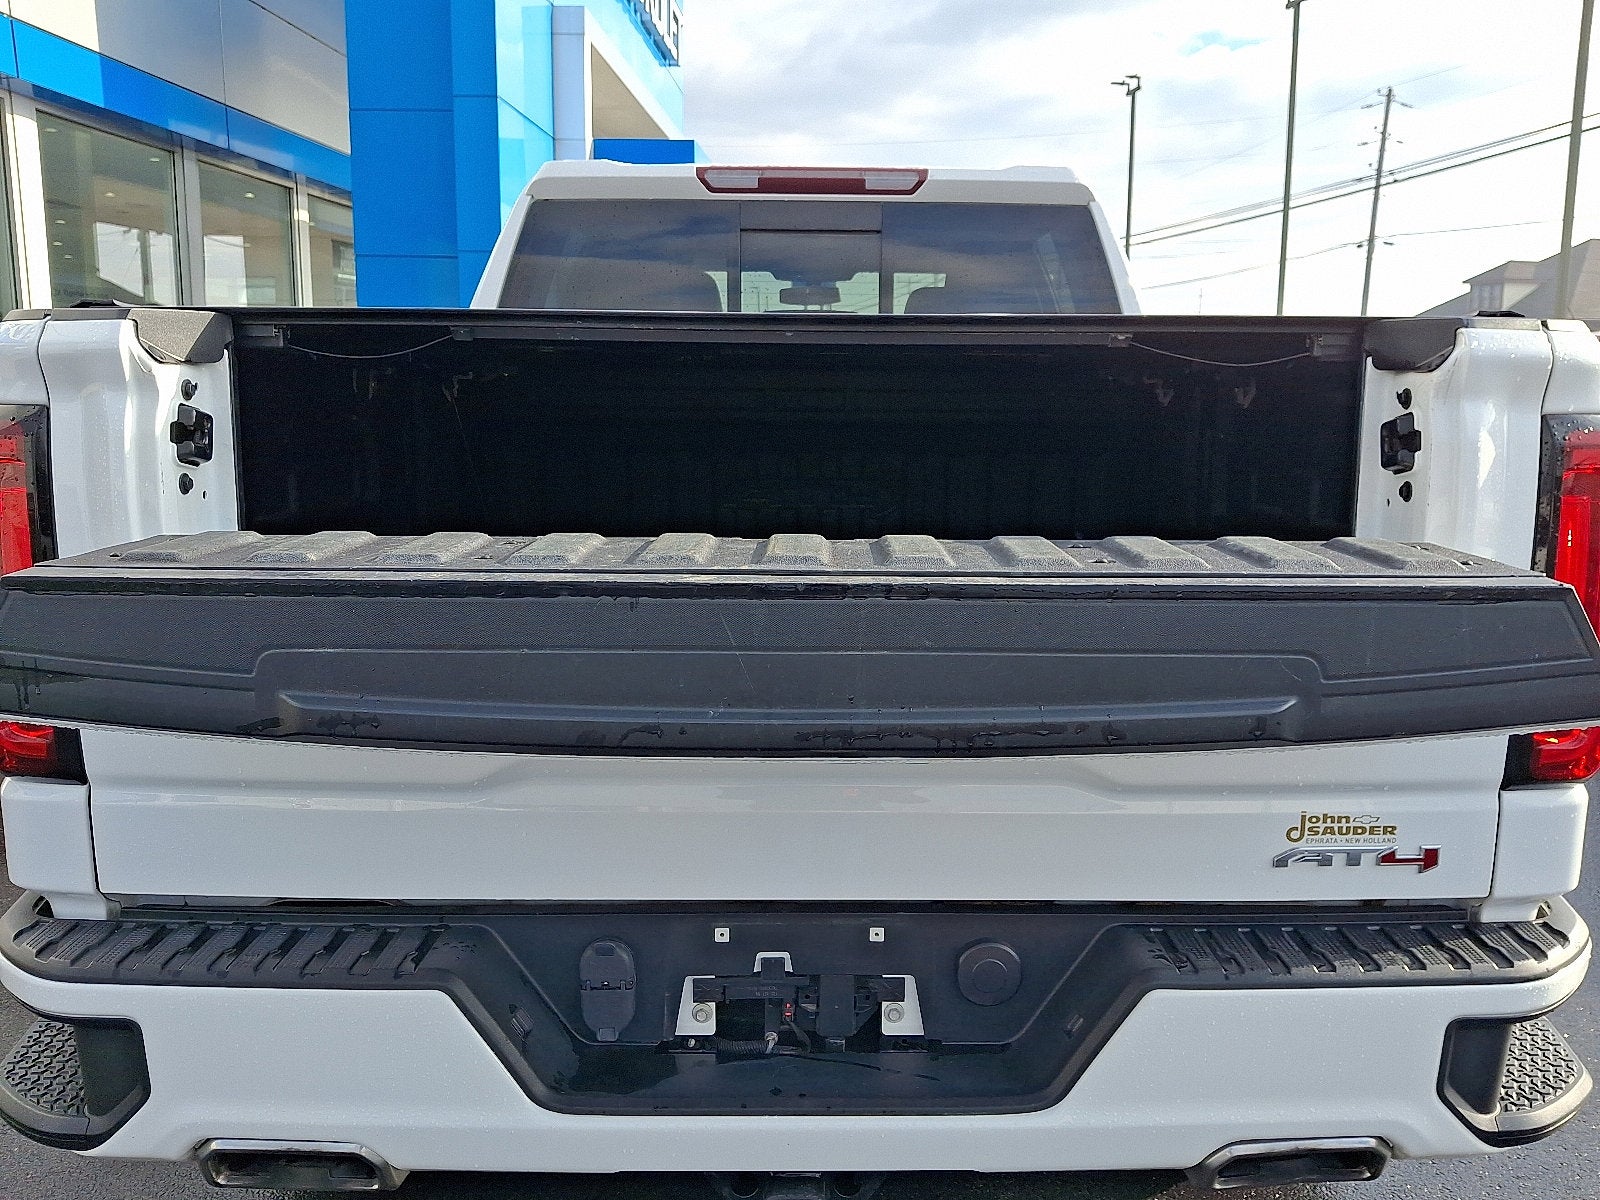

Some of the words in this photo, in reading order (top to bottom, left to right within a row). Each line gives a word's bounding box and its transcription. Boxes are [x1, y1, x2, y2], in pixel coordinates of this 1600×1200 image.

[1286, 811, 1351, 843] john
[1307, 825, 1397, 836] SAUDER
[1272, 844, 1441, 874] AT4
